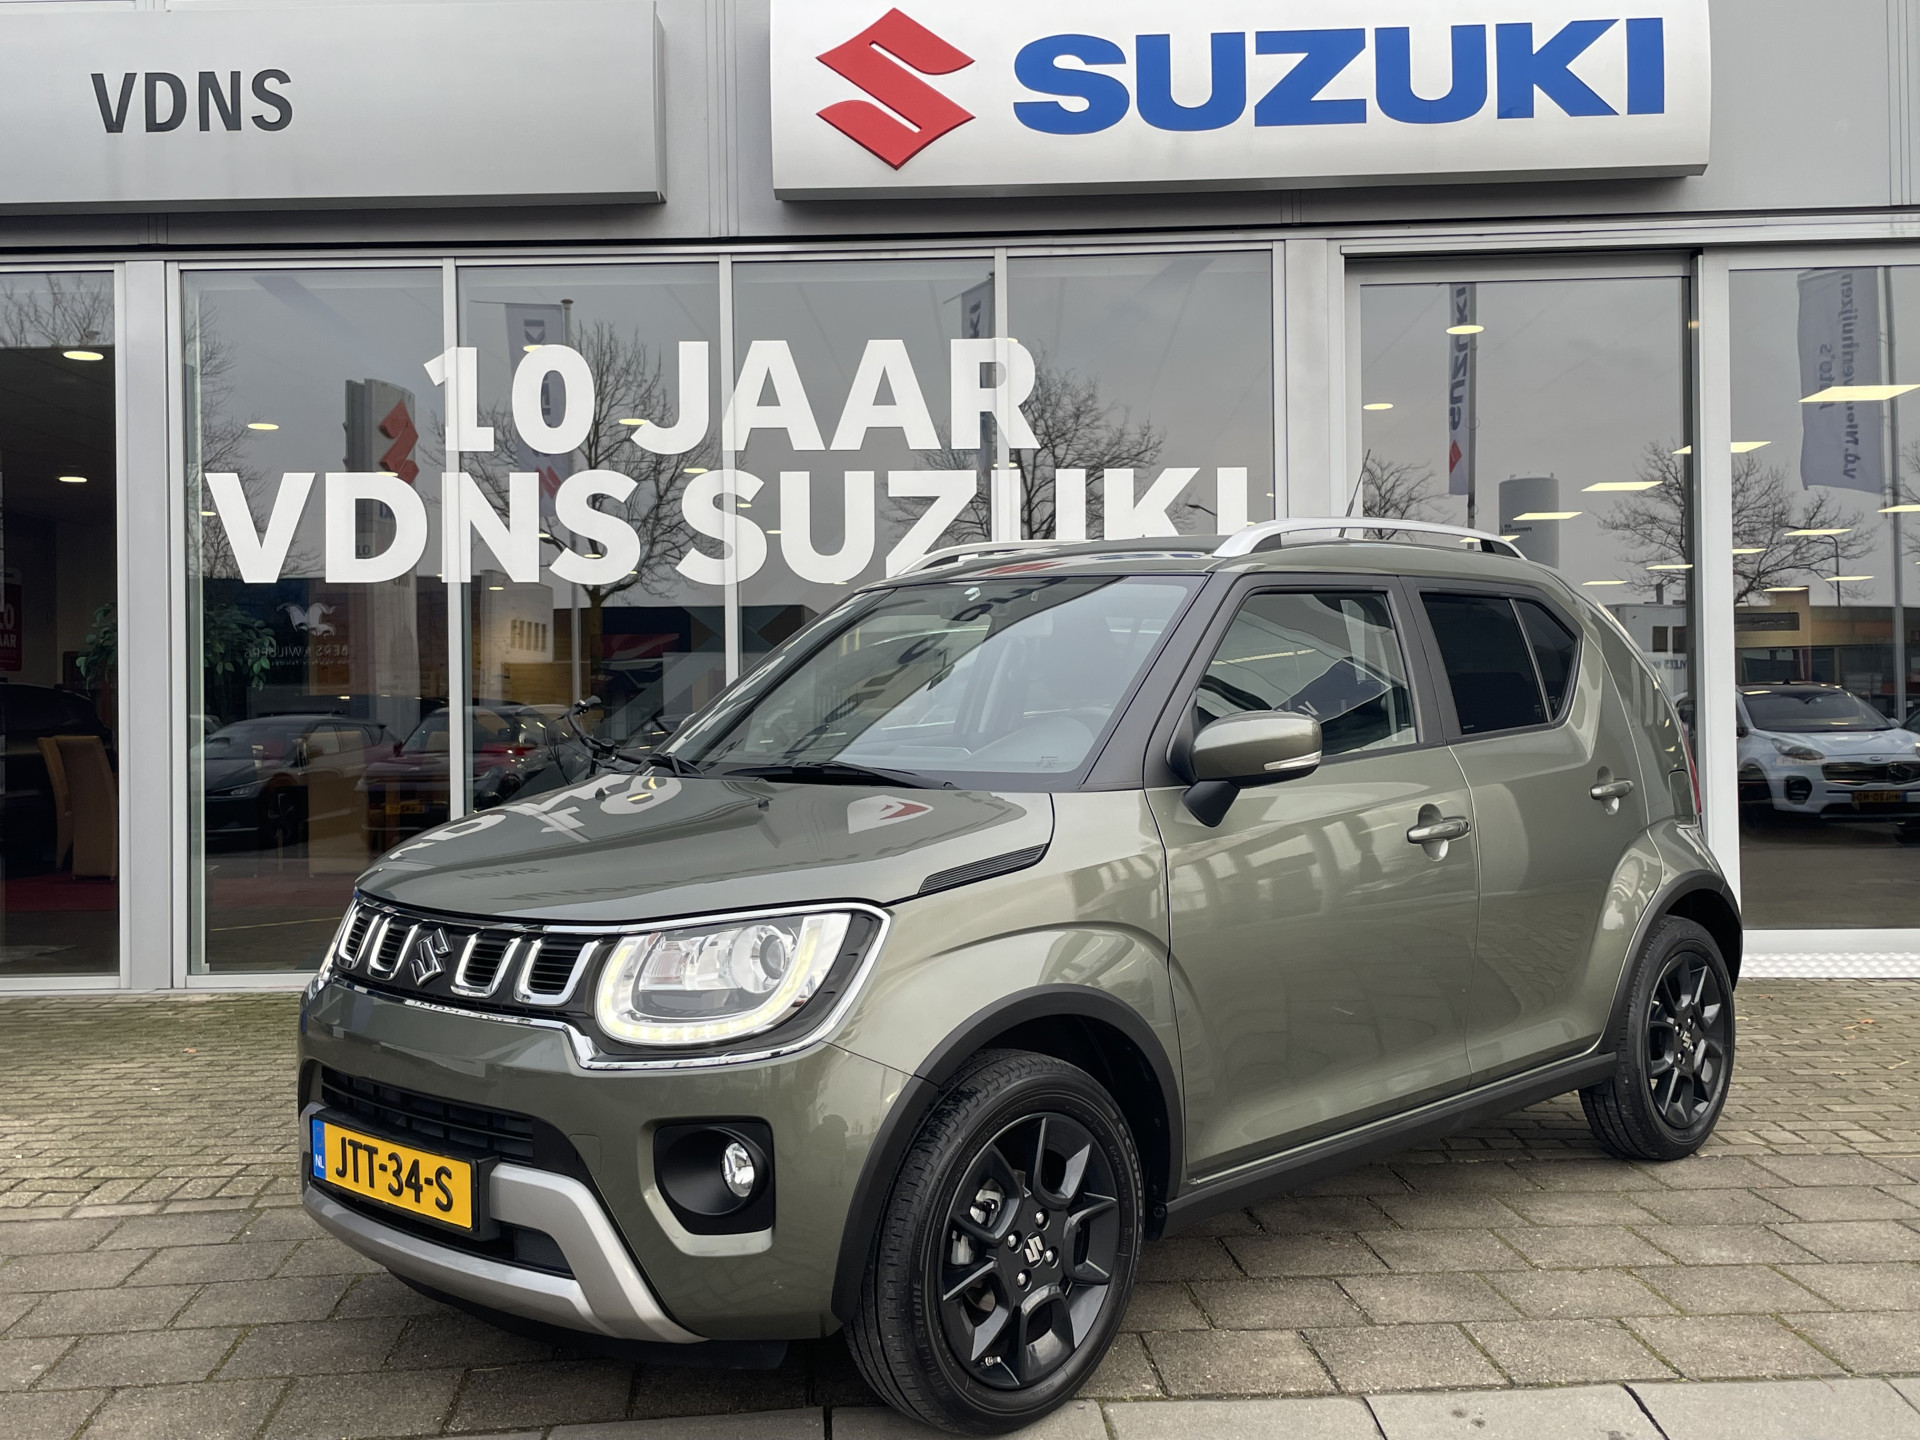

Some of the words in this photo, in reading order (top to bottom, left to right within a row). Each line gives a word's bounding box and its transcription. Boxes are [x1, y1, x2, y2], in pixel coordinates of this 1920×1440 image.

[91, 68, 293, 134] VDNS
[1014, 18, 1665, 134] SUZUKI
[424, 344, 595, 454] 10
[631, 337, 1040, 455] JAAR
[206, 469, 640, 585] VDNS
[676, 466, 1248, 585] SUZUKI
[315, 1153, 324, 1169] NL
[336, 1137, 453, 1212] JTT-34-S
